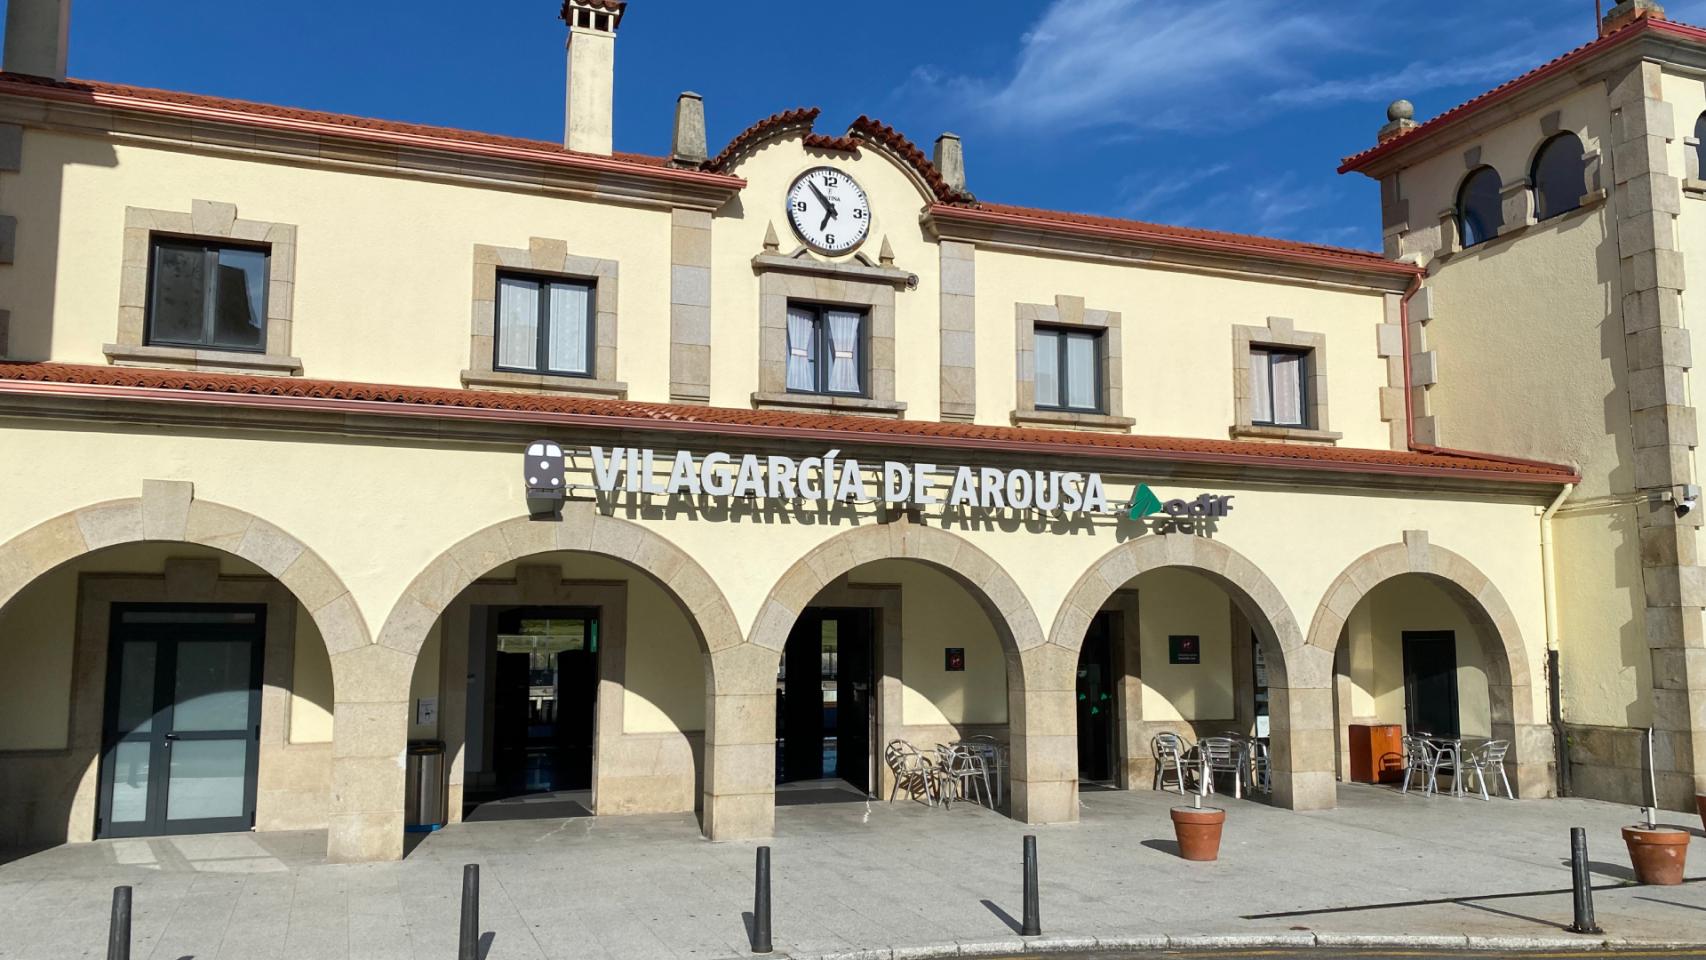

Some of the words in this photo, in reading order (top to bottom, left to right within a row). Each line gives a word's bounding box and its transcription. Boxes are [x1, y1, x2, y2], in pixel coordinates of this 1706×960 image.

[823, 176, 838, 188] 12
[797, 201, 807, 212] 9
[853, 208, 862, 219] 3
[825, 234, 835, 245] 6
[590, 445, 866, 501] VILAGARCÍA
[883, 461, 937, 505] DE
[951, 466, 1109, 514] AROUSA
[1165, 493, 1235, 517] adif
